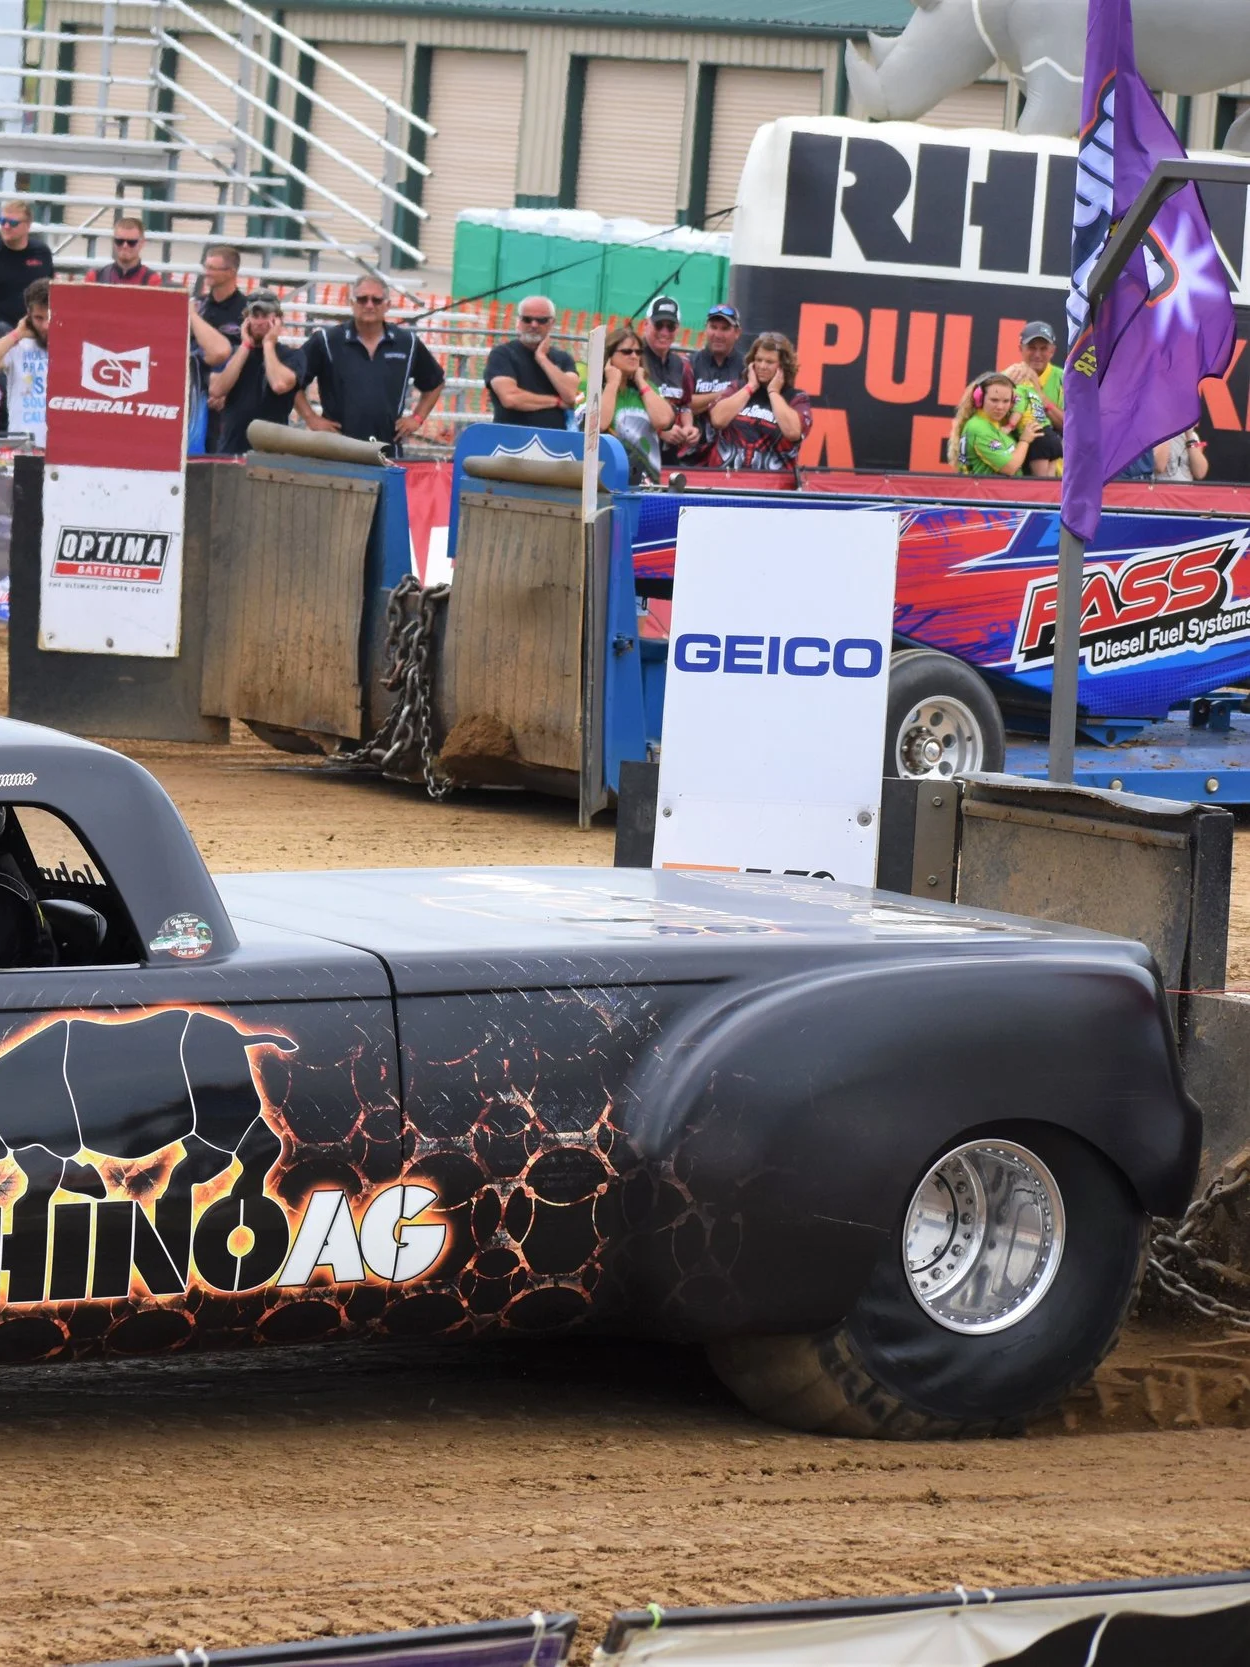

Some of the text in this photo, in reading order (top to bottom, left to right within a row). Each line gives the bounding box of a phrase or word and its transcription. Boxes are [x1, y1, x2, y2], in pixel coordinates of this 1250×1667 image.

[48, 396, 180, 420] GENERAL TIRE
[61, 533, 164, 564] OPTIMA
[77, 565, 142, 579] BATTERIES
[65, 582, 99, 590] ULTIMATE
[131, 586, 160, 595] SOURCE
[674, 633, 883, 678] GEICO
[1094, 631, 1145, 663] Diesel
[1149, 622, 1184, 650] Fuel
